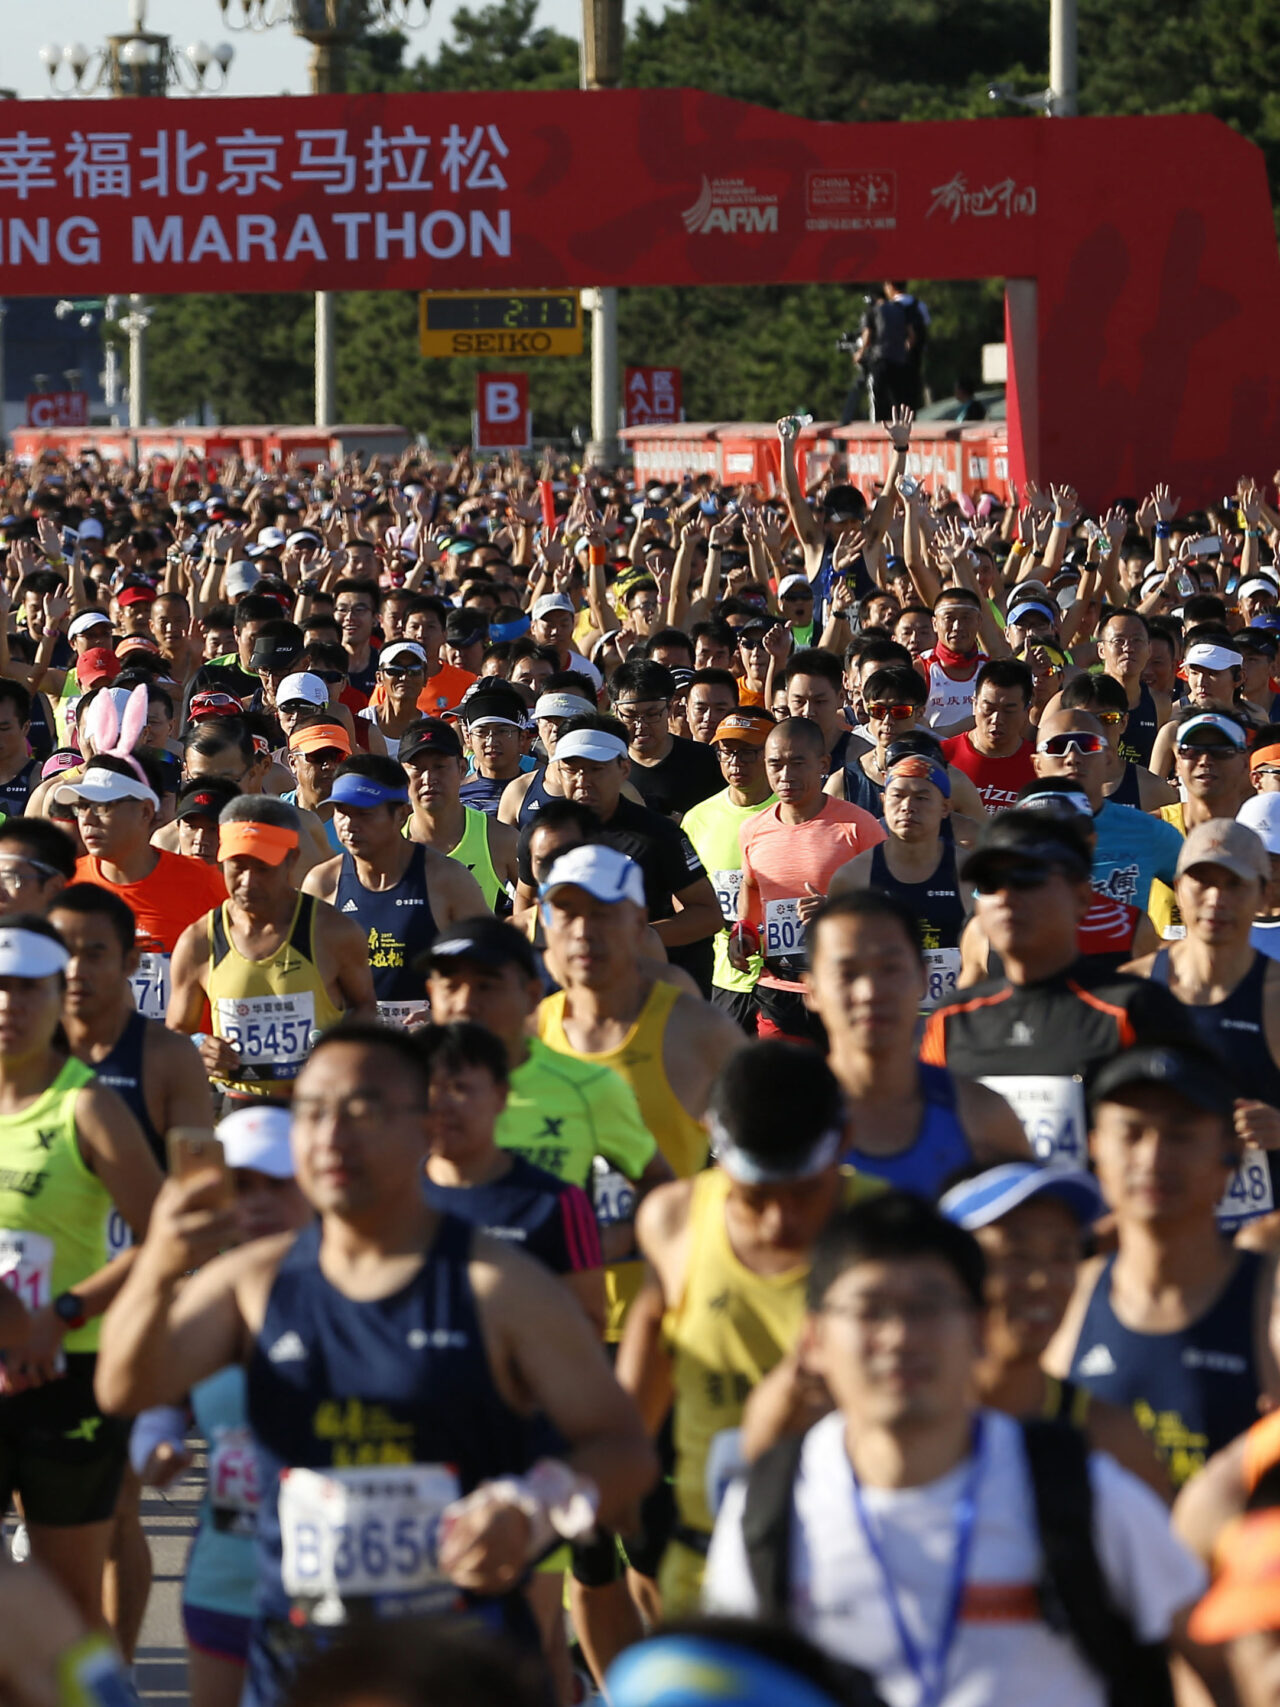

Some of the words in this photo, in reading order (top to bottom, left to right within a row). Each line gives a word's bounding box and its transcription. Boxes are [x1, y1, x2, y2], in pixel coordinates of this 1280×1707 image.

[701, 205, 779, 234] APM
[131, 209, 511, 264] MARATHON
[452, 332, 552, 353] SEIKO
[484, 382, 519, 423] B
[128, 979, 165, 1011] 71
[252, 1001, 295, 1014] 华夏幸福
